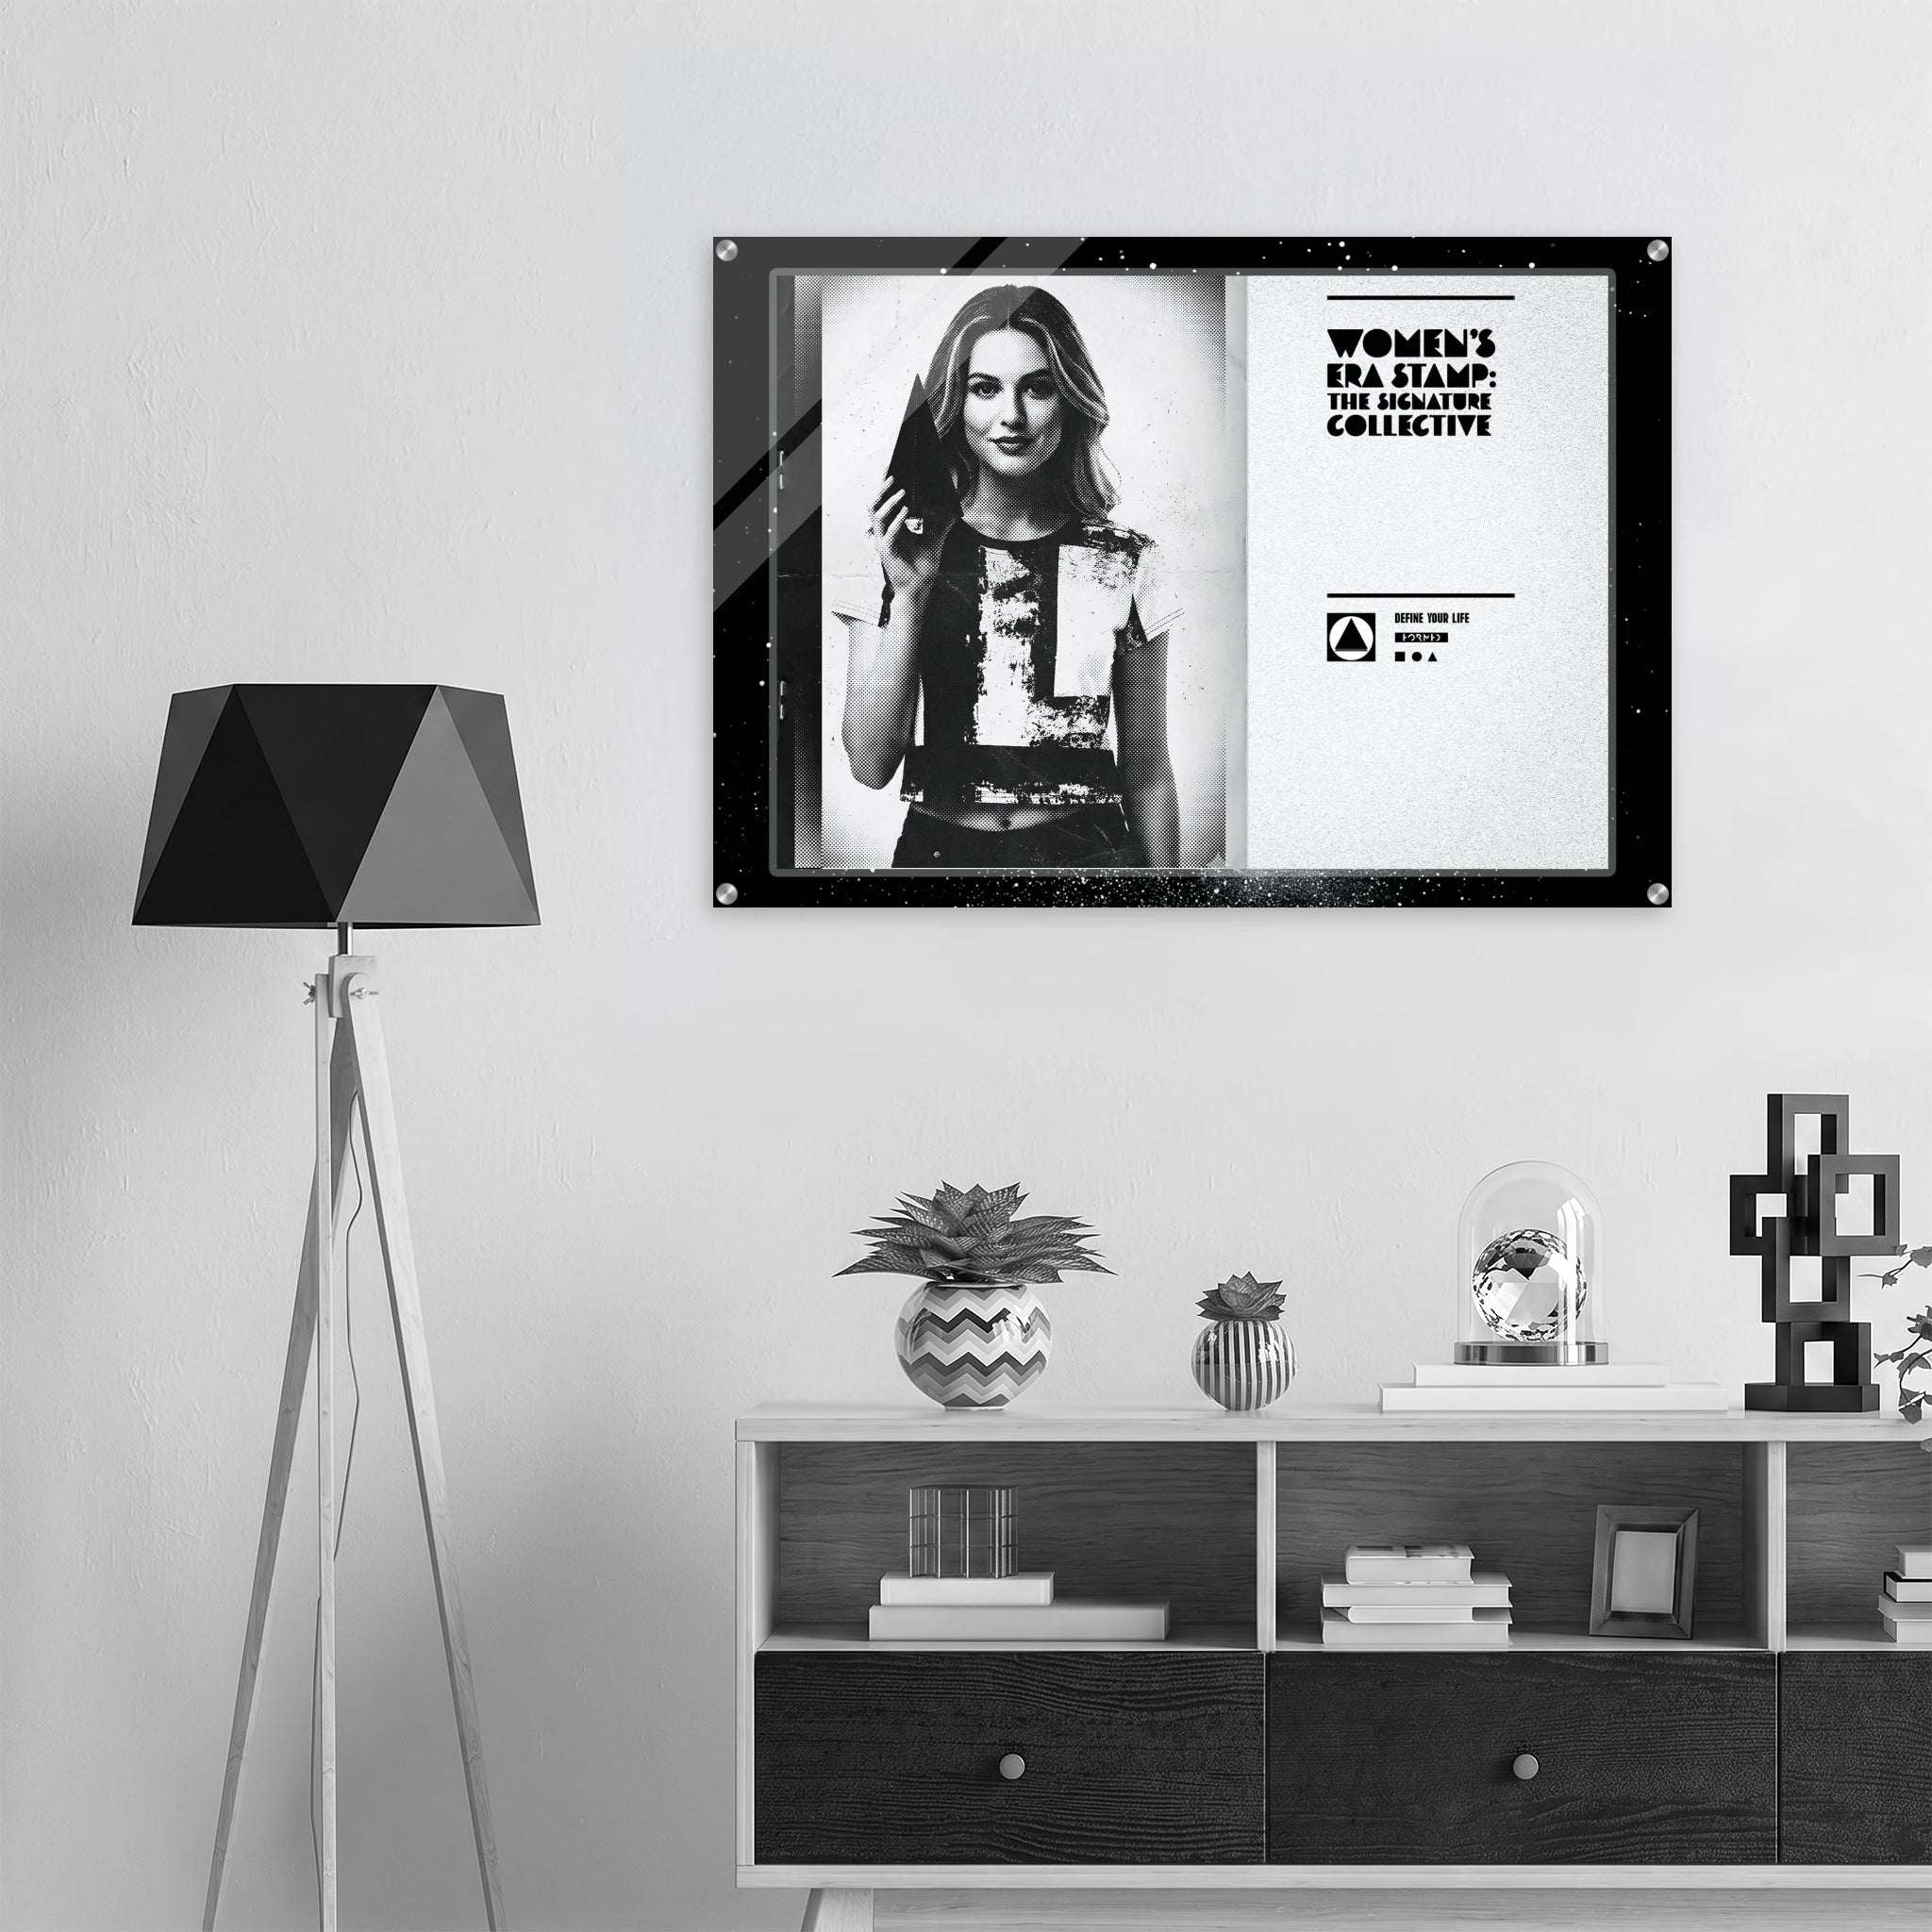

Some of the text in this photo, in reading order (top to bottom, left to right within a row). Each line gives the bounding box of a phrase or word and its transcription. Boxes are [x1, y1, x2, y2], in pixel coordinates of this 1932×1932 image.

[1327, 328, 1496, 358] WOMEN'S
[1327, 362, 1496, 388] ERA STAMP:
[1327, 392, 1492, 409] THE SIGNATURE
[1327, 414, 1492, 437] COLLECTIVE
[1394, 612, 1470, 624] DEFINE YOUR LIFE
